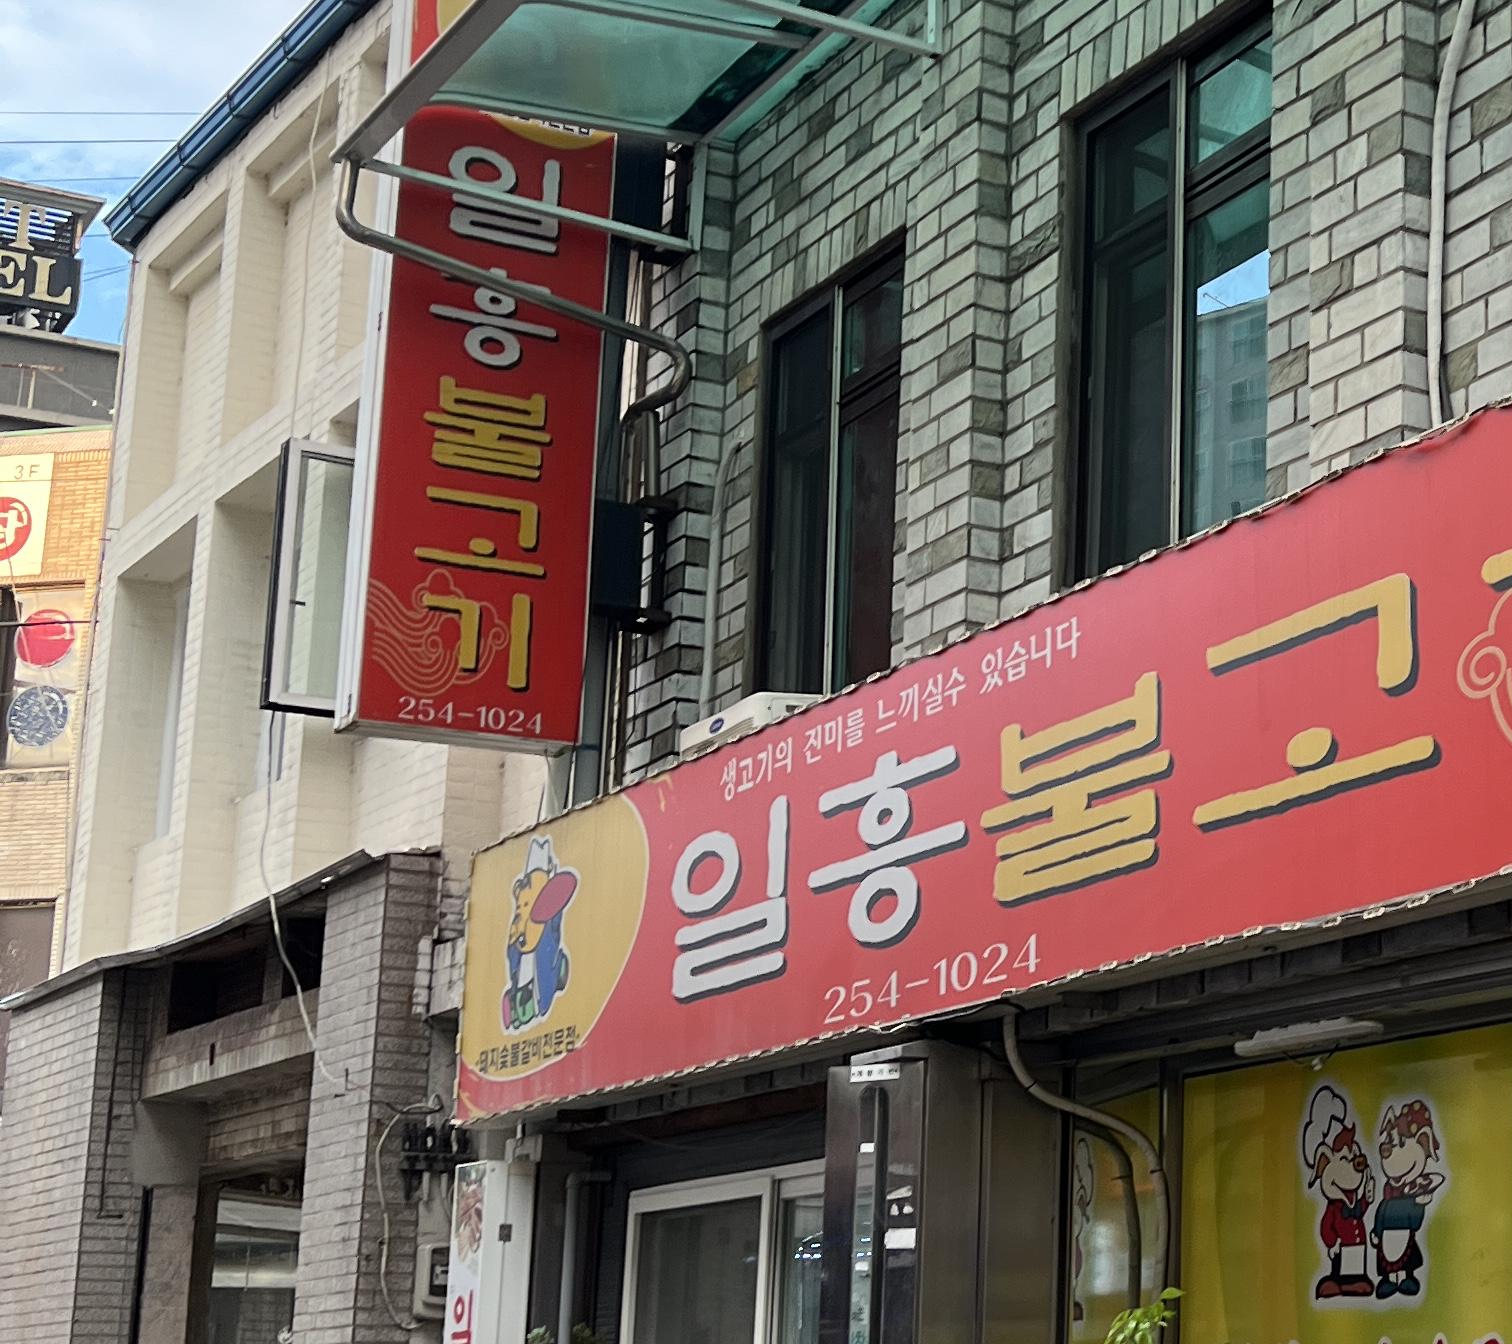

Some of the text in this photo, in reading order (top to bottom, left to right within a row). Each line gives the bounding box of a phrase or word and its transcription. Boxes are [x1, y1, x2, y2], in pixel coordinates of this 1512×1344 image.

[399, 694, 543, 736] 254-1024
[719, 616, 1082, 802] 생고기의 진미를 느끼실수 있습니다
[823, 933, 1041, 1025] 254-1024
